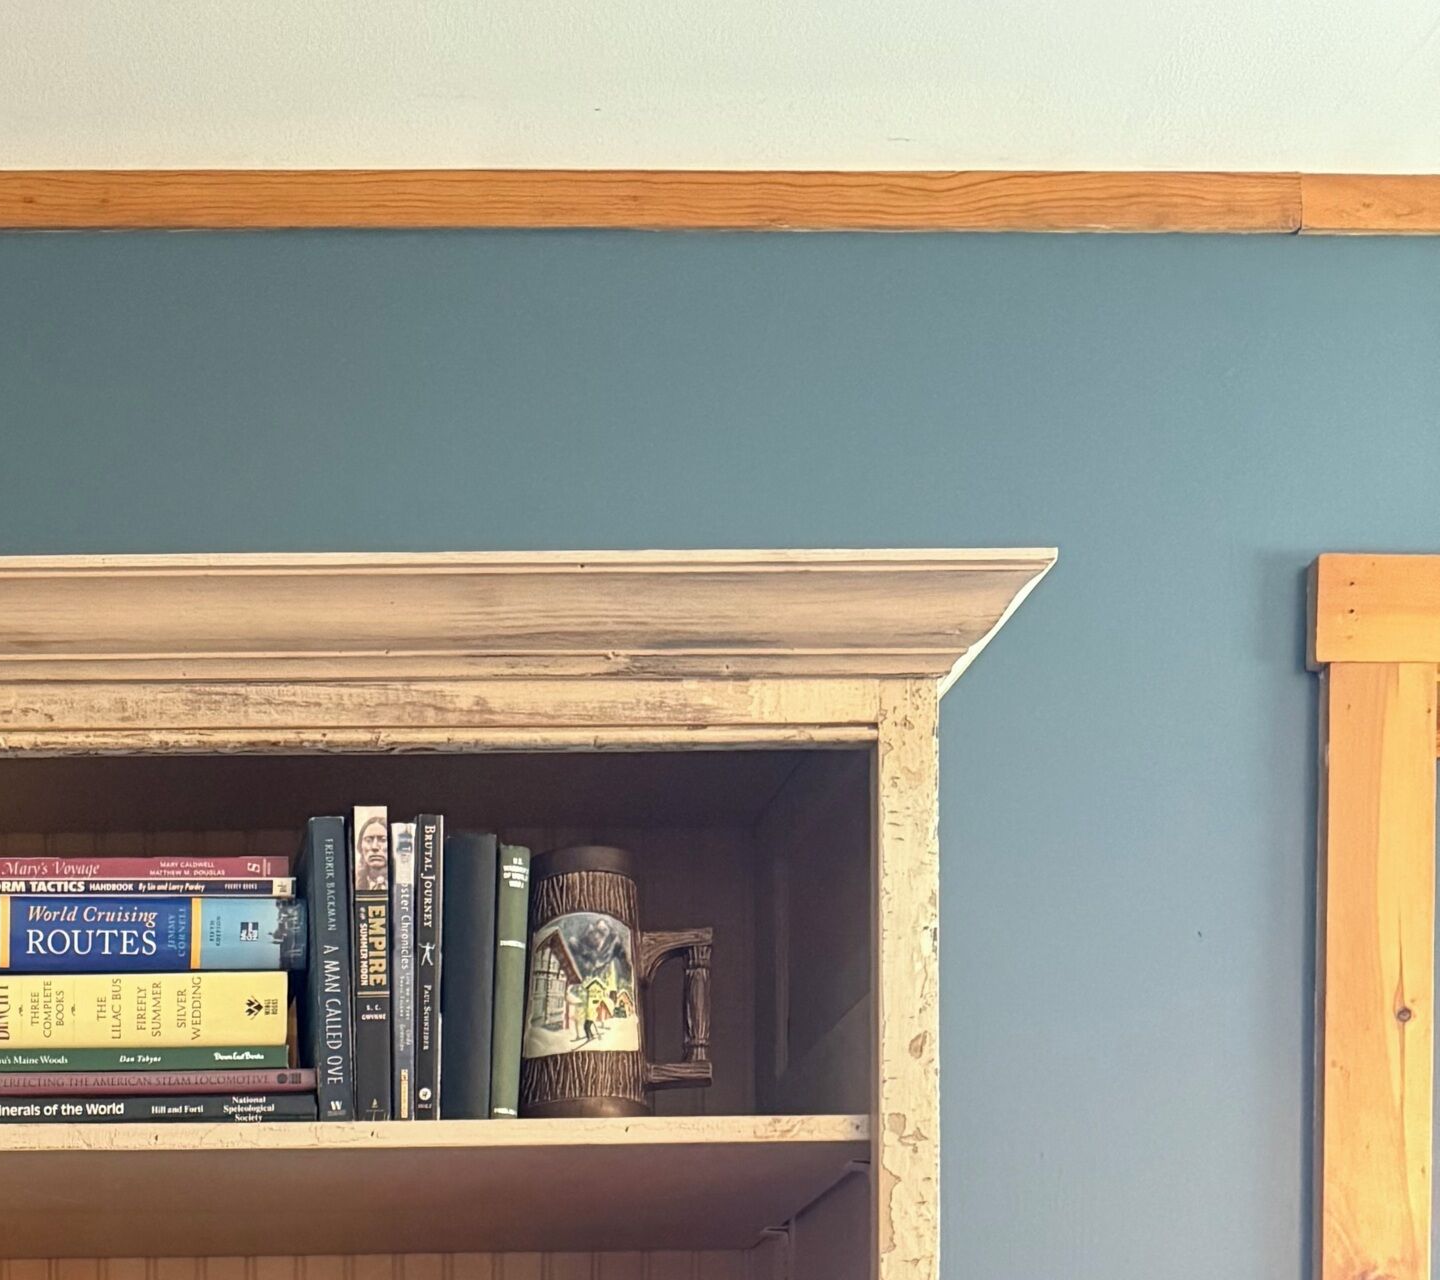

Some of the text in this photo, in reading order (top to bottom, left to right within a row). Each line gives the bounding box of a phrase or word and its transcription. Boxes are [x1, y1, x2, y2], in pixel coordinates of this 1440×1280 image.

[29, 881, 86, 893] TACTICS
[89, 883, 134, 891] HANDBOOK
[324, 838, 337, 931] FREDRIK BACKMAN
[28, 905, 158, 928] World Cruising
[178, 908, 187, 957] CORNELL
[26, 929, 157, 956] ROUTES
[359, 923, 368, 986] SUMMER MOON
[367, 905, 386, 986] EMPIRE
[400, 915, 412, 970] Chronicles
[31, 992, 40, 1026] THREE
[43, 980, 52, 1038] COMPLETE
[56, 990, 65, 1026] BOOKS
[97, 996, 106, 1021] THE
[112, 978, 122, 1039] LILAC BUS
[136, 986, 146, 1031] FIREFLY
[152, 981, 161, 1037] SUMMER
[177, 989, 187, 1028] SILVER
[191, 976, 202, 1040] WEDDING
[423, 984, 432, 1051] PAUL SCHNEIDER
[44, 1103, 58, 1116] of
[61, 1103, 83, 1115] the
[85, 1102, 124, 1115] World
[232, 1096, 266, 1104] National
